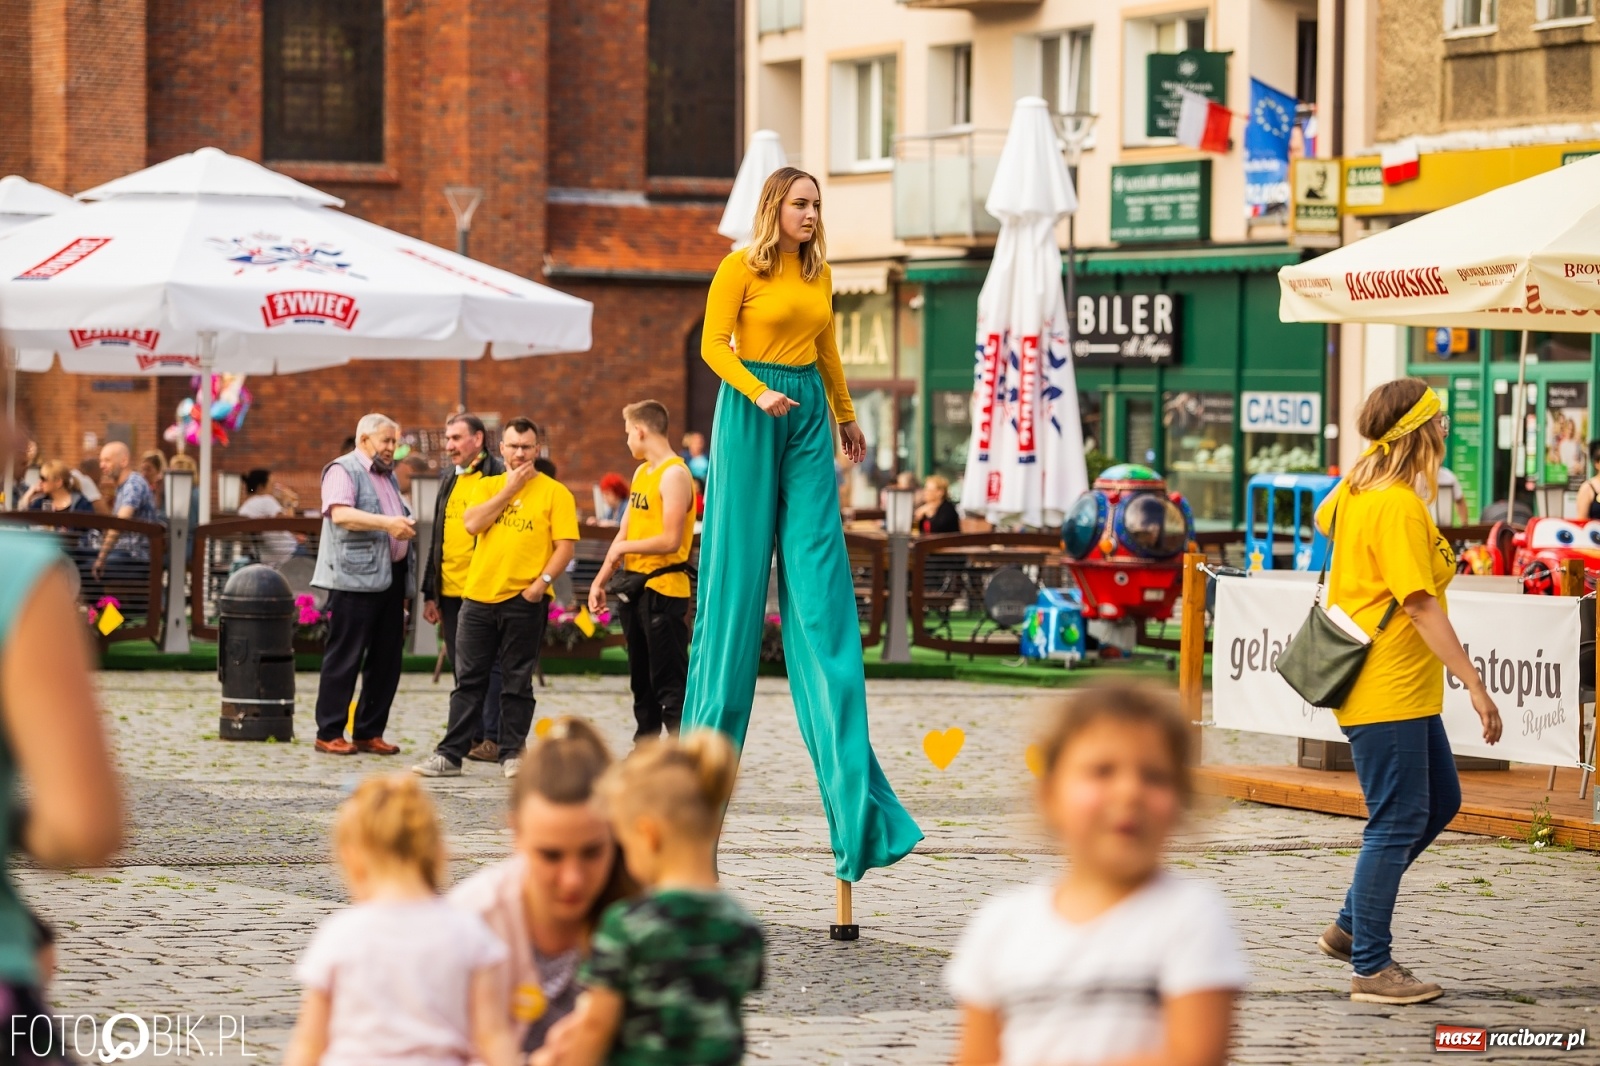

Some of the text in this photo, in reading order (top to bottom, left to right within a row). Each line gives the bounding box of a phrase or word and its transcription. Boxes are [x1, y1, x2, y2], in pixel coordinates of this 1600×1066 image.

[1345, 266, 1449, 301] RACIBORSKIE
[1457, 263, 1518, 281] BROWAR ZAMKOWY
[272, 292, 350, 319] ŻYWIEC
[1077, 294, 1173, 335] BILER
[1247, 399, 1313, 425] CASIO
[1522, 698, 1566, 740] Rynek
